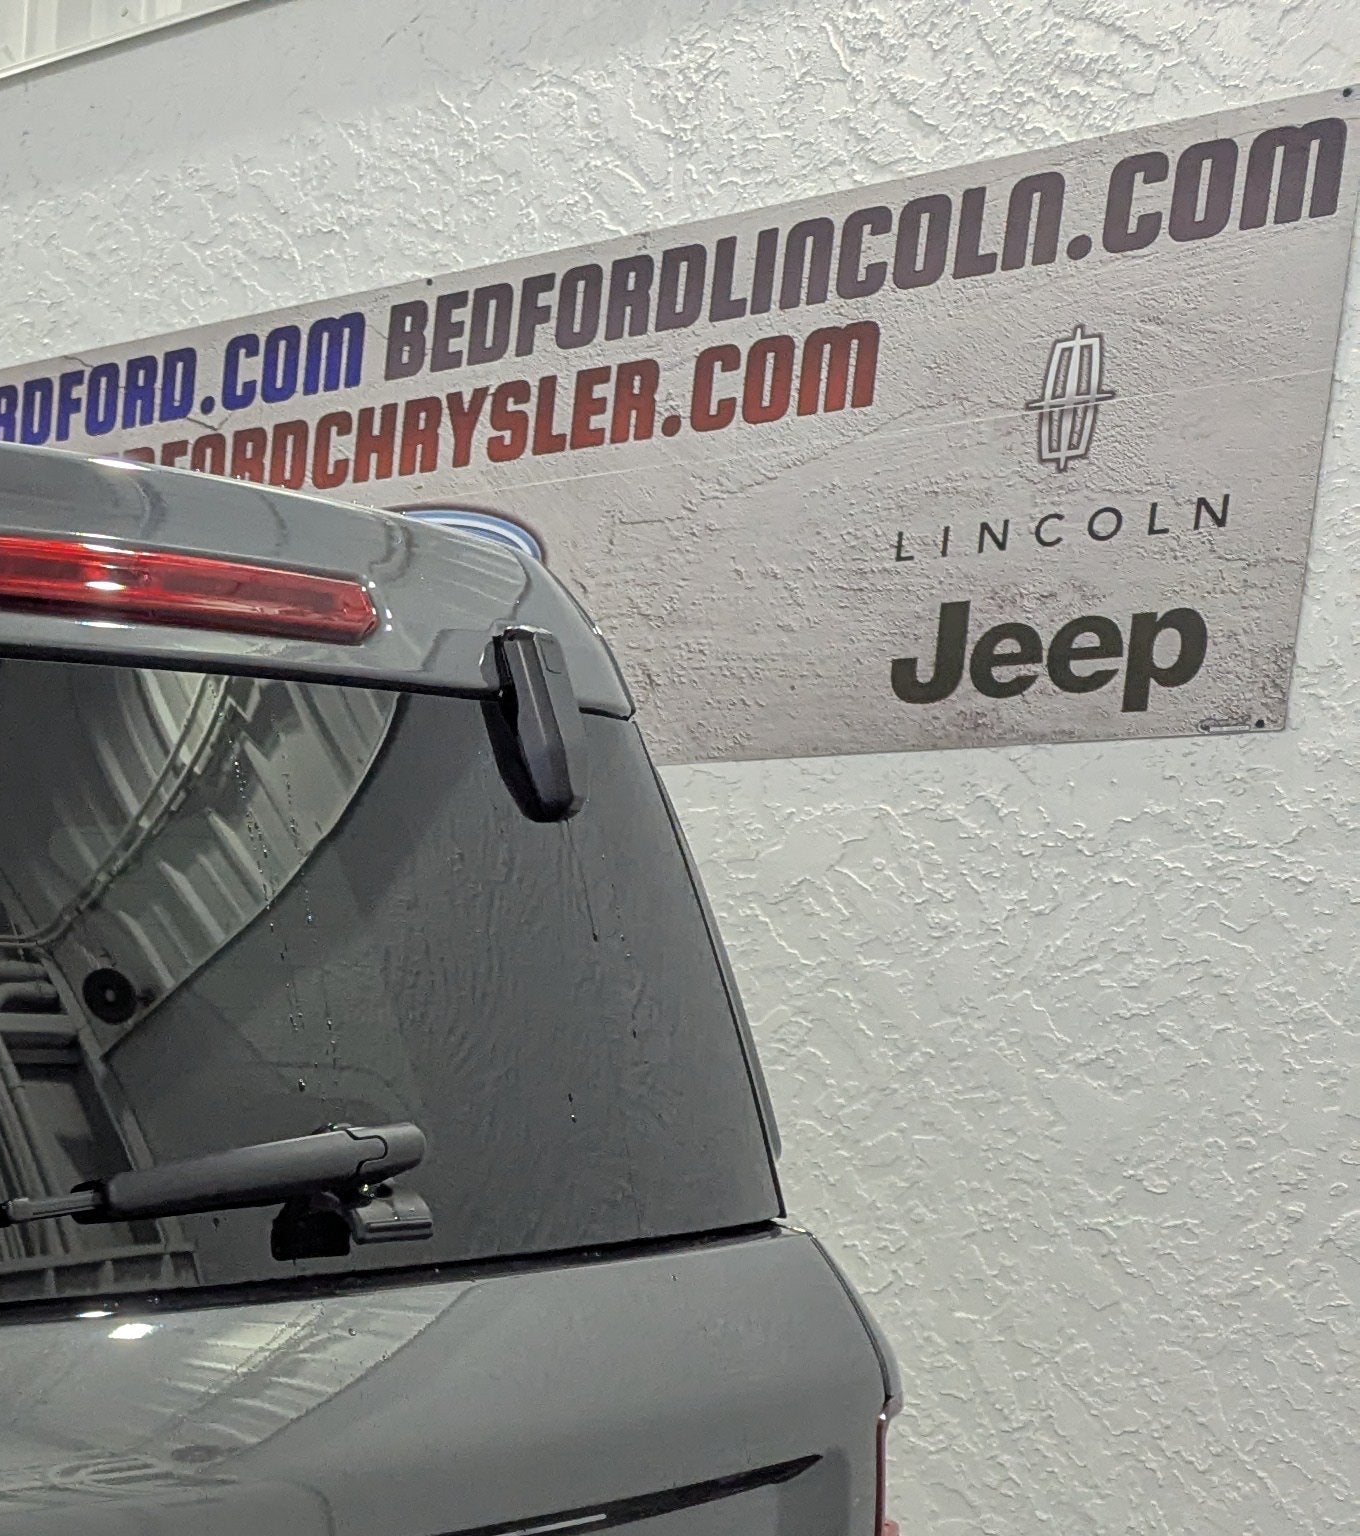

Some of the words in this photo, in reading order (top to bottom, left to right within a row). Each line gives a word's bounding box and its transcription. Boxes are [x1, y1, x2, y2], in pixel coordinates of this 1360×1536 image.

[384, 117, 1349, 381] BEDFORDLINCOLN.COM
[895, 494, 1231, 563] LINCOLN
[890, 600, 1209, 713] Jeep
